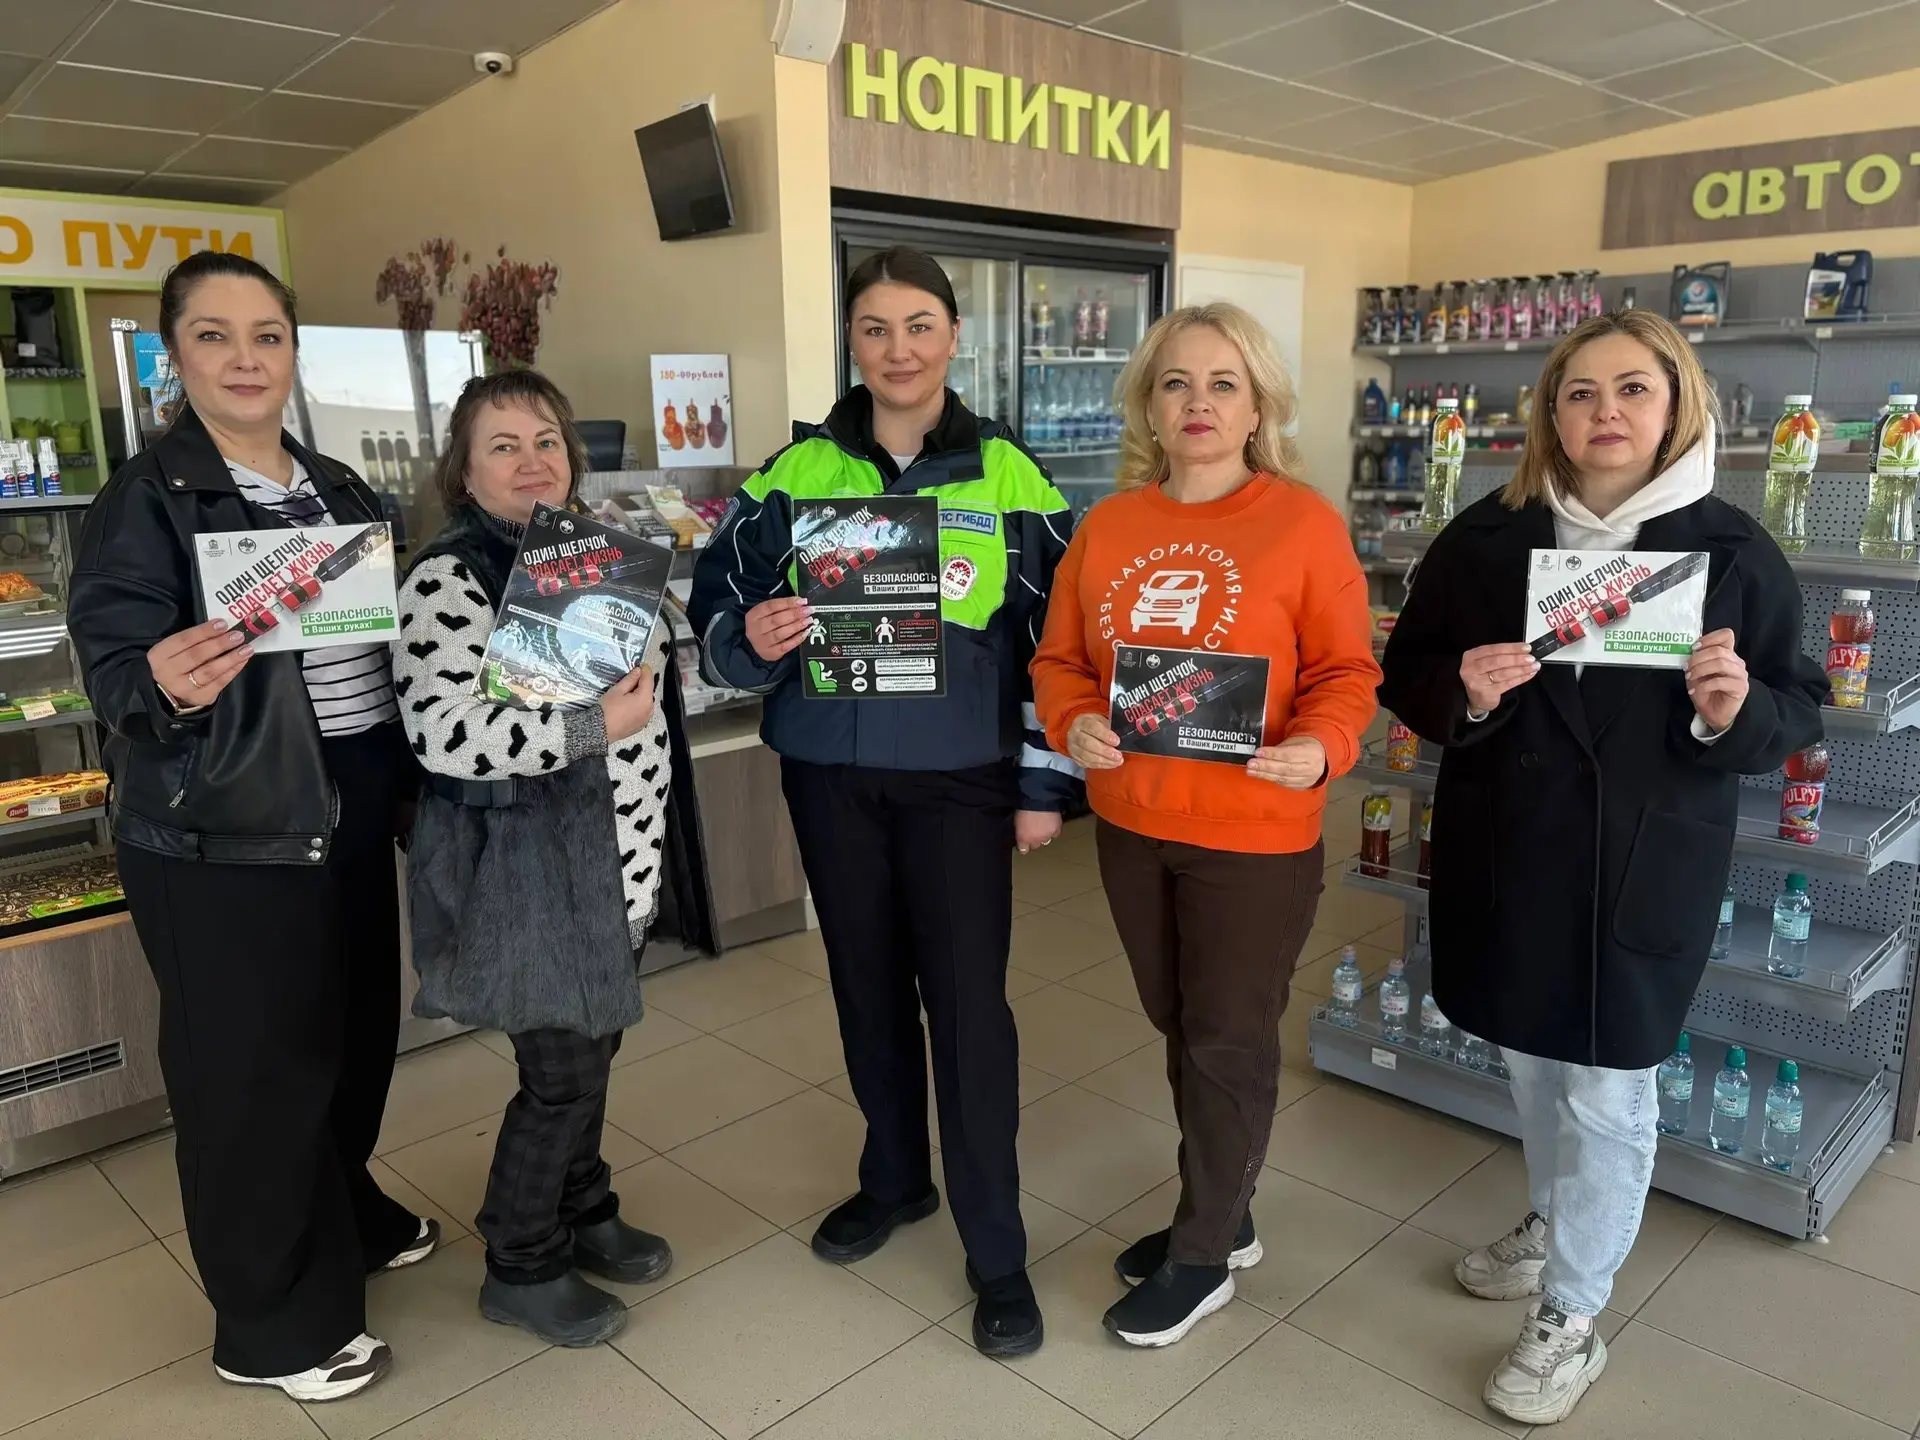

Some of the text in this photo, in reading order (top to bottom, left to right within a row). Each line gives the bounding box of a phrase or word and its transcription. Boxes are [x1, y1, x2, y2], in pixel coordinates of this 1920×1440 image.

[62, 219, 254, 269] ПУТИ
[955, 513, 992, 529] ГИБДД
[523, 533, 609, 566] ОДИН ЩЕЛЧОК
[527, 546, 624, 581] СПАСАЕТ ЖИЗНЬ
[215, 531, 314, 606] ОДИН ЩЕЛЧОК
[228, 540, 336, 620] СПАСАЕТ ЖИЗНЬ
[863, 572, 938, 584] БЕЗОПАСНОСТЬ
[1110, 542, 1242, 595] ЛАБОРАТОРИЯ
[1537, 554, 1632, 615] ОДИН ЩЕЛЧОК
[872, 585, 896, 593] Ваших
[897, 584, 920, 593] руках!
[1545, 564, 1652, 629] СПАСАЕТ ЖИЗНЬ
[300, 606, 393, 624] БЕЗОПАСНОСТЬ
[304, 620, 373, 635] в Ваших руках!
[1604, 630, 1694, 643] БЕЗОПАСНОСТЬ
[1613, 641, 1641, 651] Ваших
[1643, 644, 1671, 653] руках!
[1118, 658, 1199, 709] ОДИН ЩЕЛЧОК
[1123, 668, 1215, 723] СПАСАЕТ ЖИЗНЬ
[1178, 726, 1257, 744] БЕЗОПАСНОСТЬ
[1186, 739, 1210, 749] Ваших
[1212, 741, 1237, 752] руках!
